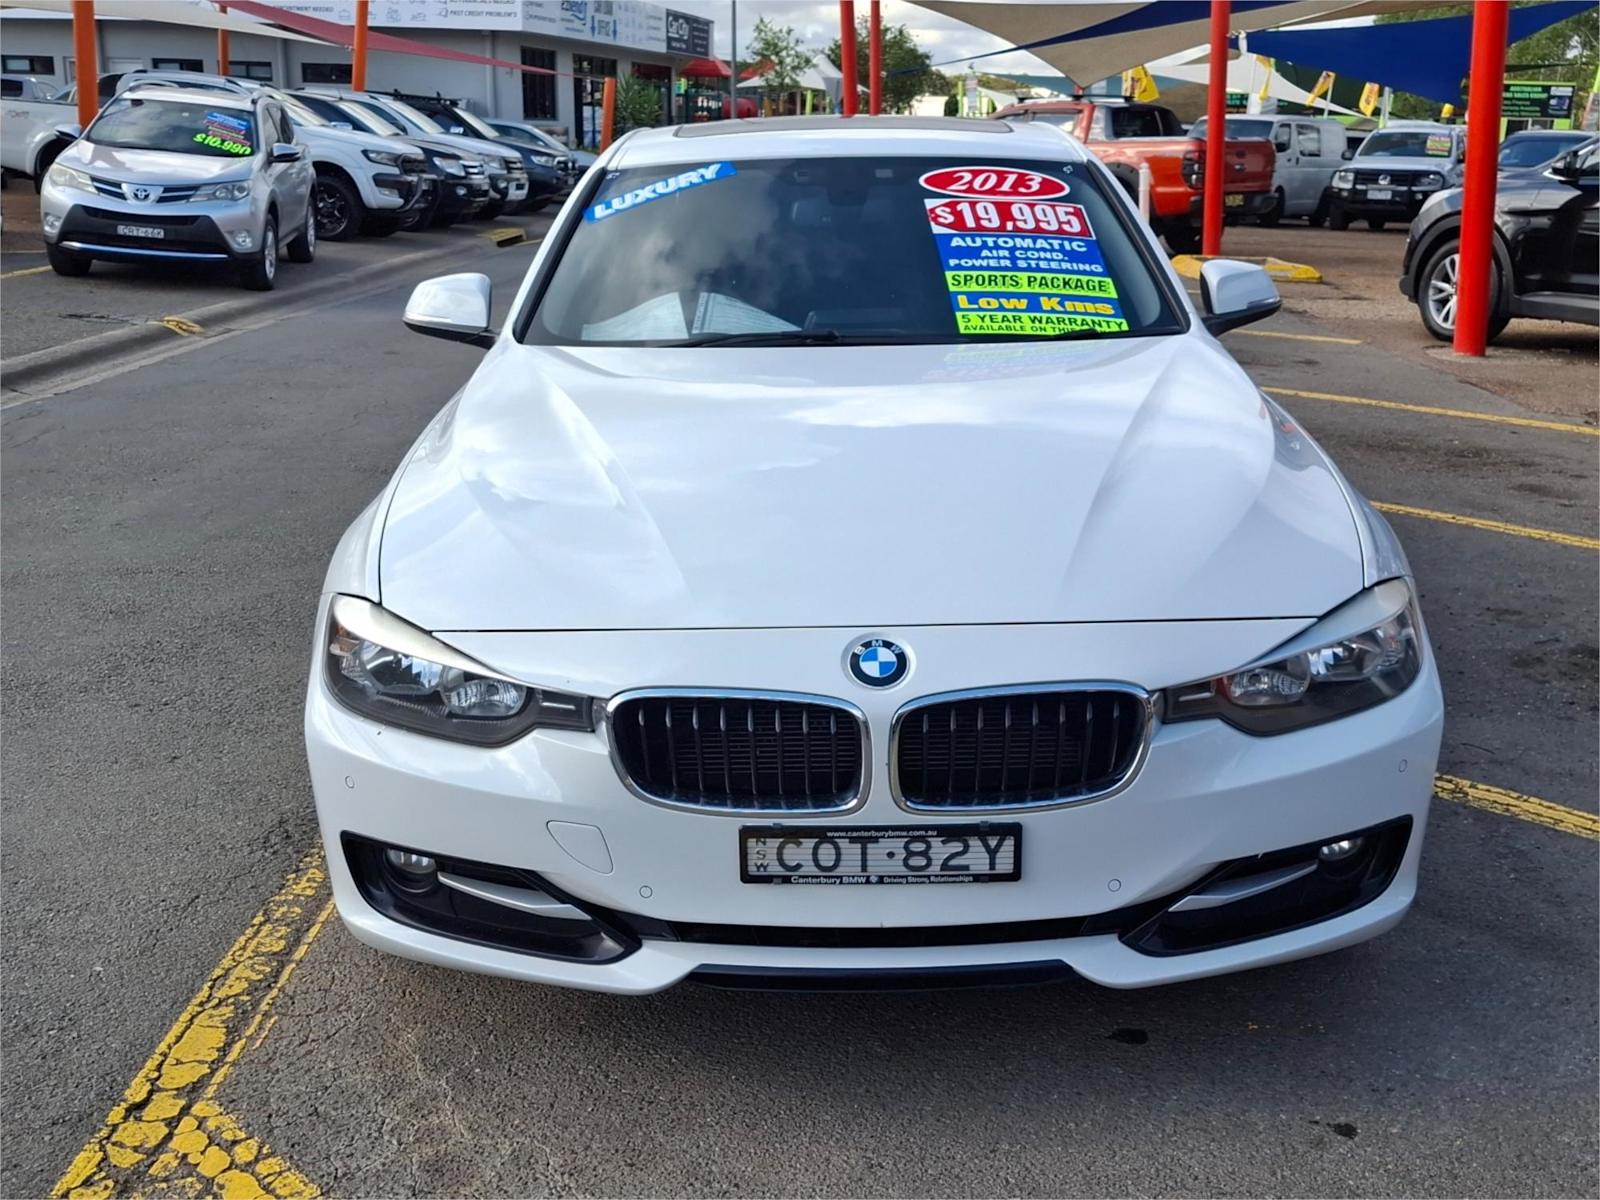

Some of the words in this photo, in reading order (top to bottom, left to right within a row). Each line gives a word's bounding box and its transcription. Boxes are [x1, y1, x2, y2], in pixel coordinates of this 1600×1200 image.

[593, 162, 722, 219] LUXURY
[946, 171, 1043, 193] 2013
[936, 202, 1082, 234] $19,995
[950, 236, 1088, 252] AUTOMATIC
[980, 249, 1011, 258] AIR
[1014, 250, 1069, 261] COND.
[948, 258, 1012, 268] POWER
[1016, 259, 1104, 273] STEERING
[951, 274, 1021, 288] SPORTS
[1027, 275, 1111, 294] PACKAGE
[957, 294, 1028, 311] Low
[1040, 296, 1116, 315] Kms
[961, 314, 971, 324] 5
[975, 314, 1024, 325] YEAR
[1030, 315, 1125, 332] WARRANTY
[963, 323, 1028, 333] AVAILABLE
[1030, 325, 1047, 333] ON
[854, 639, 902, 656] BMW
[826, 830, 938, 838] www.canterburybmw.com.au
[791, 876, 840, 885] Canterbury
[842, 876, 867, 884] BMW
[883, 876, 907, 884] Driving
[930, 875, 973, 883] Relationships
